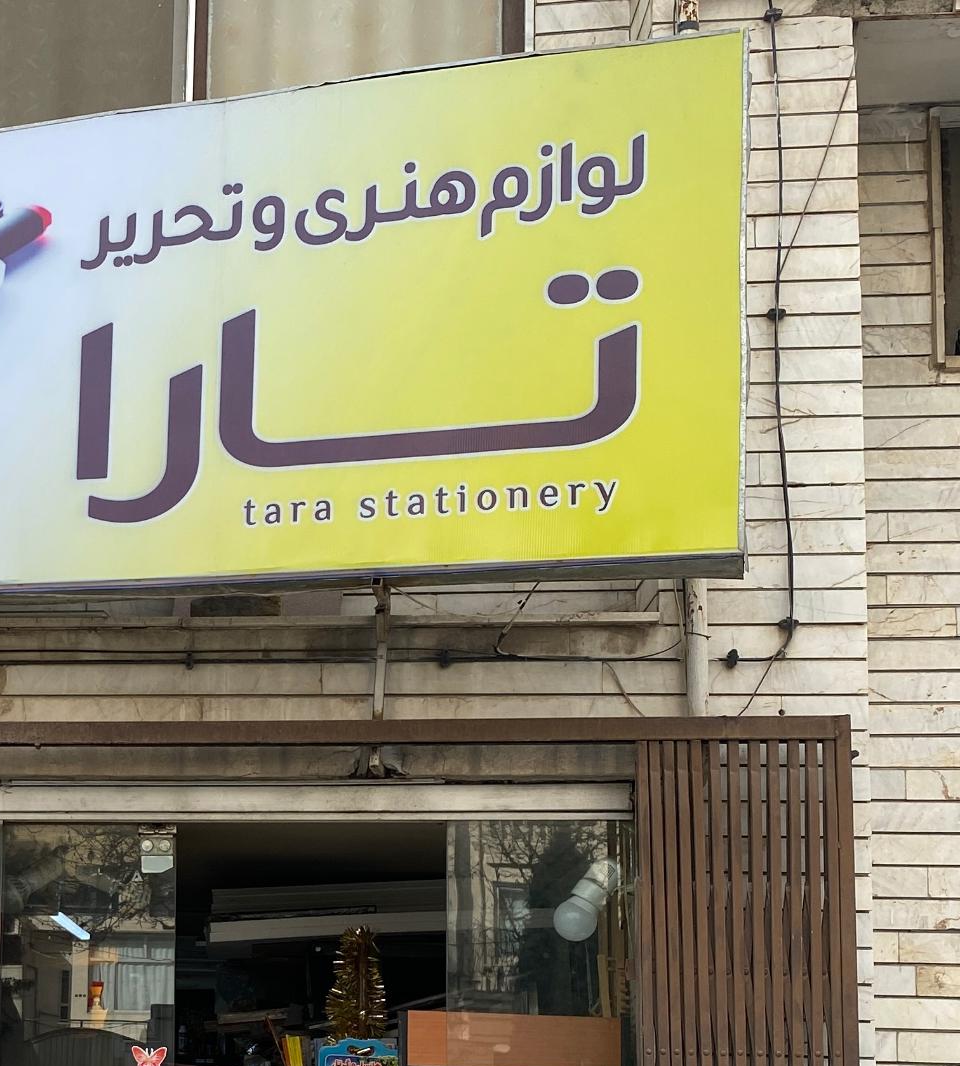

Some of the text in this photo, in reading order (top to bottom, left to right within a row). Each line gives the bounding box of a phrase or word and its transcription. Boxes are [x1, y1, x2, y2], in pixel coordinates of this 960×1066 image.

[81, 133, 645, 270] لوازم هنری و تحریر
[76, 269, 640, 523] تارا
[243, 479, 618, 526] tara stationery
